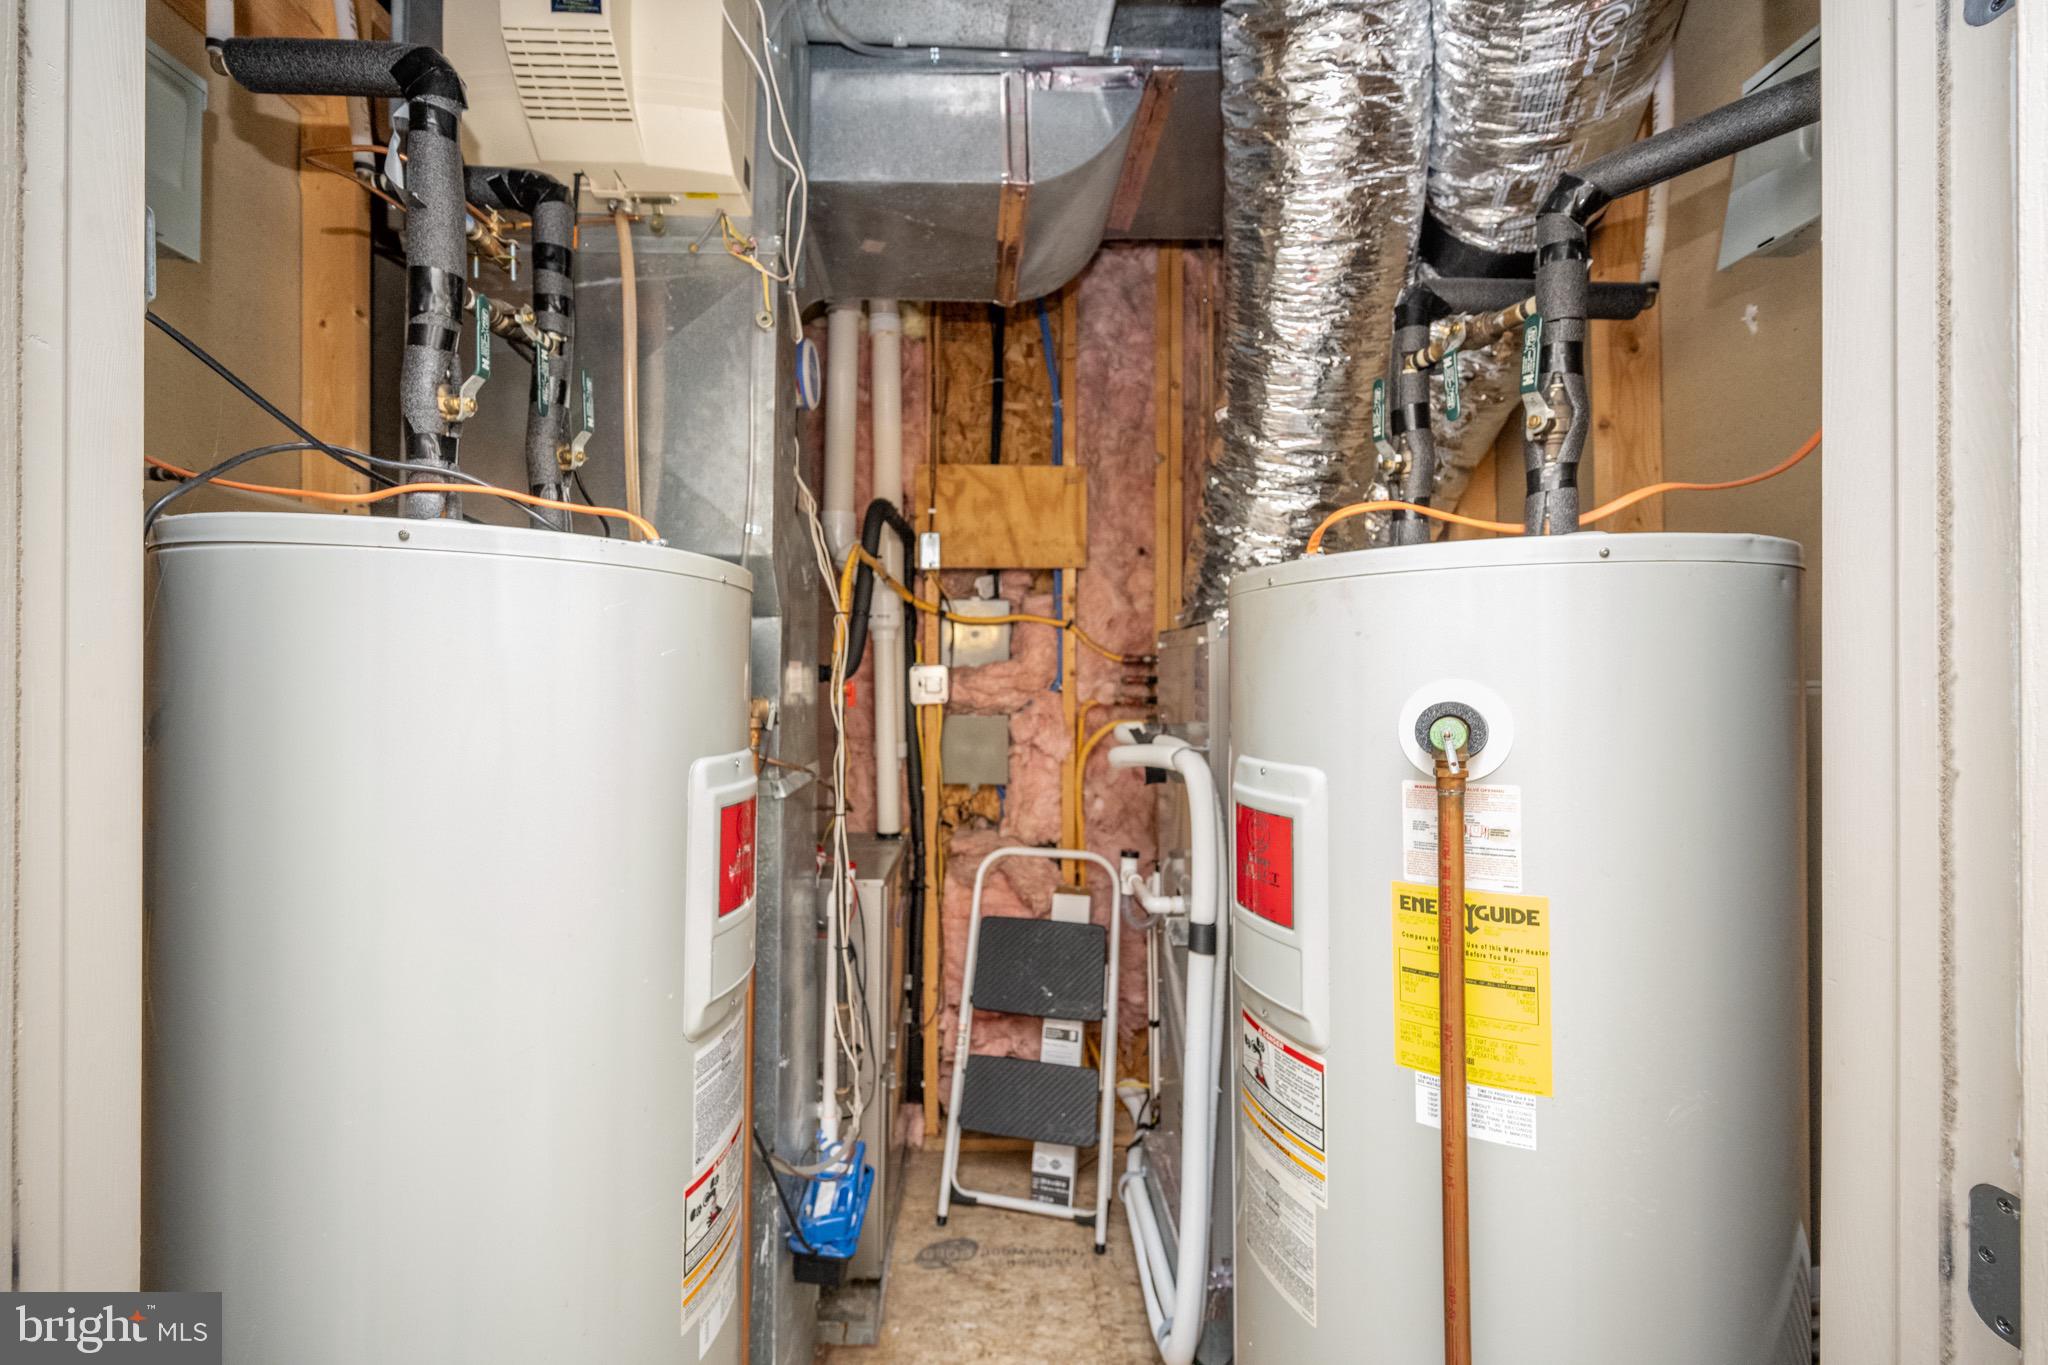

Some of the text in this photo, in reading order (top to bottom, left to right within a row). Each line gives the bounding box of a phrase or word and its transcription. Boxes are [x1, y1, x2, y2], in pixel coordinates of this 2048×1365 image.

[1399, 894, 1541, 934] ENEYGUIDE
[1401, 931, 1429, 944] Compare
[1465, 950, 1487, 960] Before
[1489, 953, 1501, 961] You
[1466, 941, 1479, 949] Use
[1489, 944, 1502, 952] this
[1504, 946, 1524, 954] Water
[1525, 948, 1549, 957] Heater
